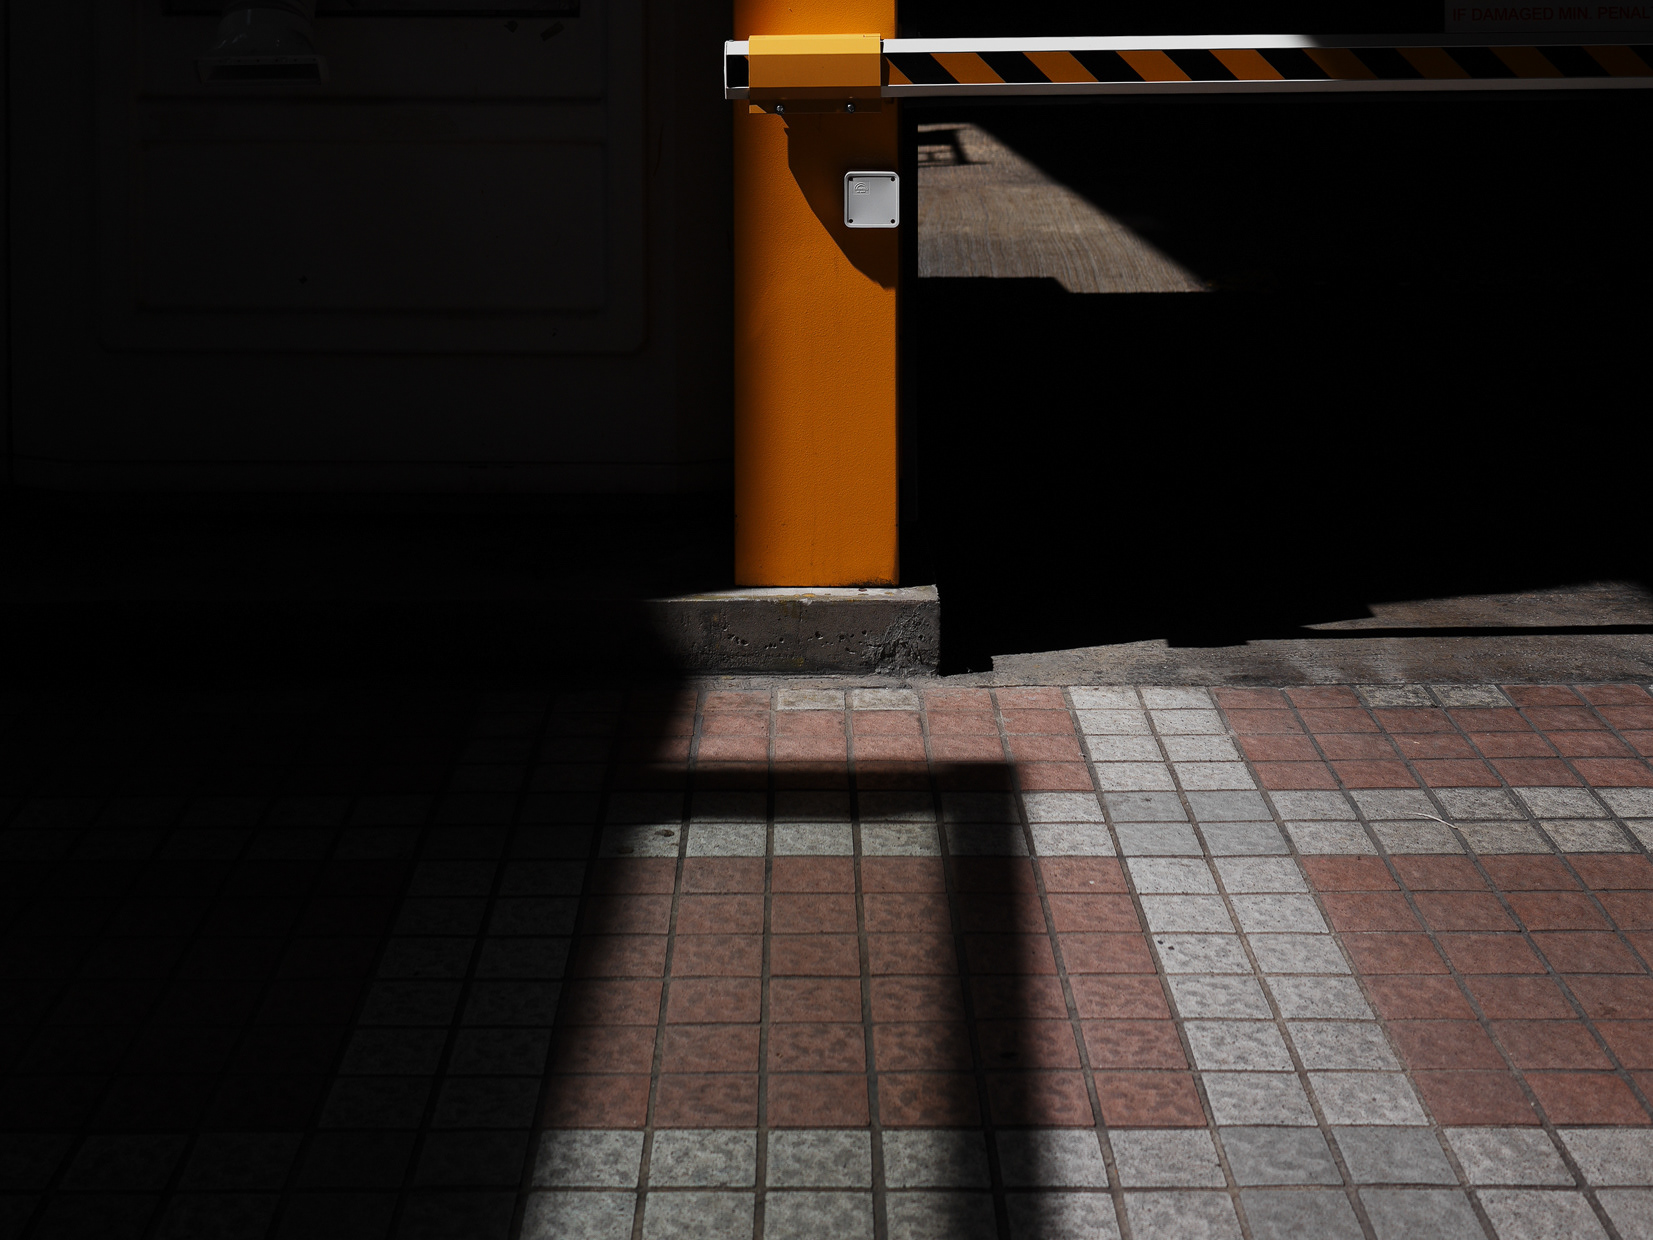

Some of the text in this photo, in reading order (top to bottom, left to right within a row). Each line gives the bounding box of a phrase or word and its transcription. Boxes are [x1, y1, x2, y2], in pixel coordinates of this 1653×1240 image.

[1453, 6, 1653, 21] IF DAMAGED MIN. PENAL
